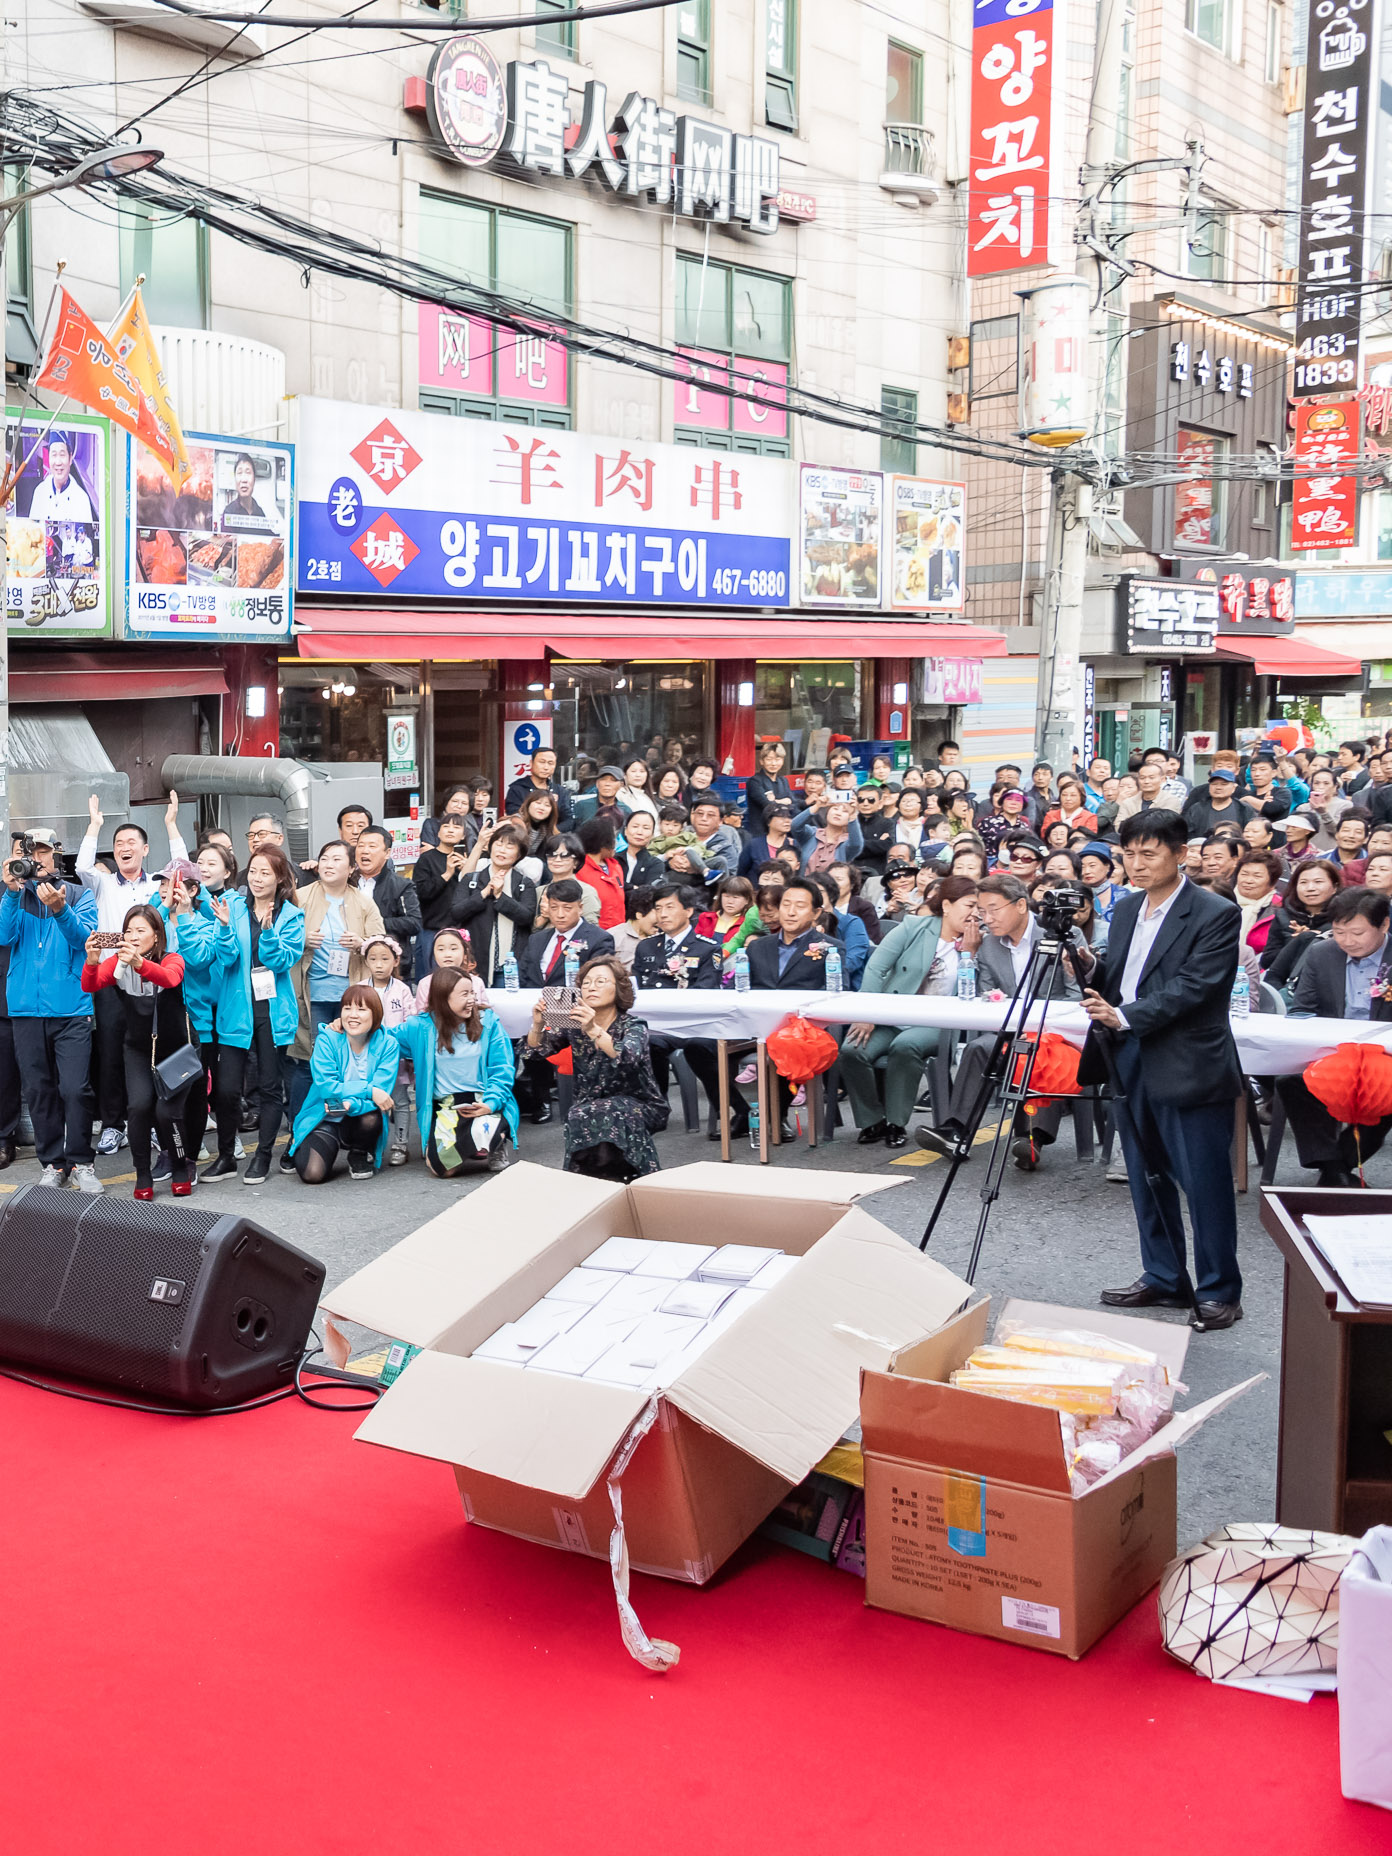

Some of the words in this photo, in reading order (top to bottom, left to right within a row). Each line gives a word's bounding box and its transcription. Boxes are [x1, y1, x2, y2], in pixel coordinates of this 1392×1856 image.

[507, 59, 780, 235] 唐人街网吧
[974, 30, 1047, 258] 양꼬치
[1296, 359, 1355, 387] 1833
[366, 435, 409, 481] 京
[489, 434, 743, 520] 羊肉串
[331, 485, 359, 527] 老
[363, 531, 406, 570] 城
[440, 519, 708, 598] 양고기꼬치구이
[712, 567, 786, 598] 467-6880
[307, 558, 342, 581] 2호점
[139, 592, 167, 610] KBS
[891, 1536, 908, 1546] ITEM
[891, 1546, 924, 1559] PRODUCT
[953, 1559, 999, 1577] TOOTHPASTE
[1000, 1571, 1019, 1581] PLUS
[891, 1555, 926, 1569] QUANTITY
[939, 1565, 952, 1575] SET
[891, 1564, 915, 1576] GROSS
[915, 1569, 943, 1582] WEIGHT
[891, 1574, 910, 1584] MADE
[920, 1581, 944, 1592] KOREA
